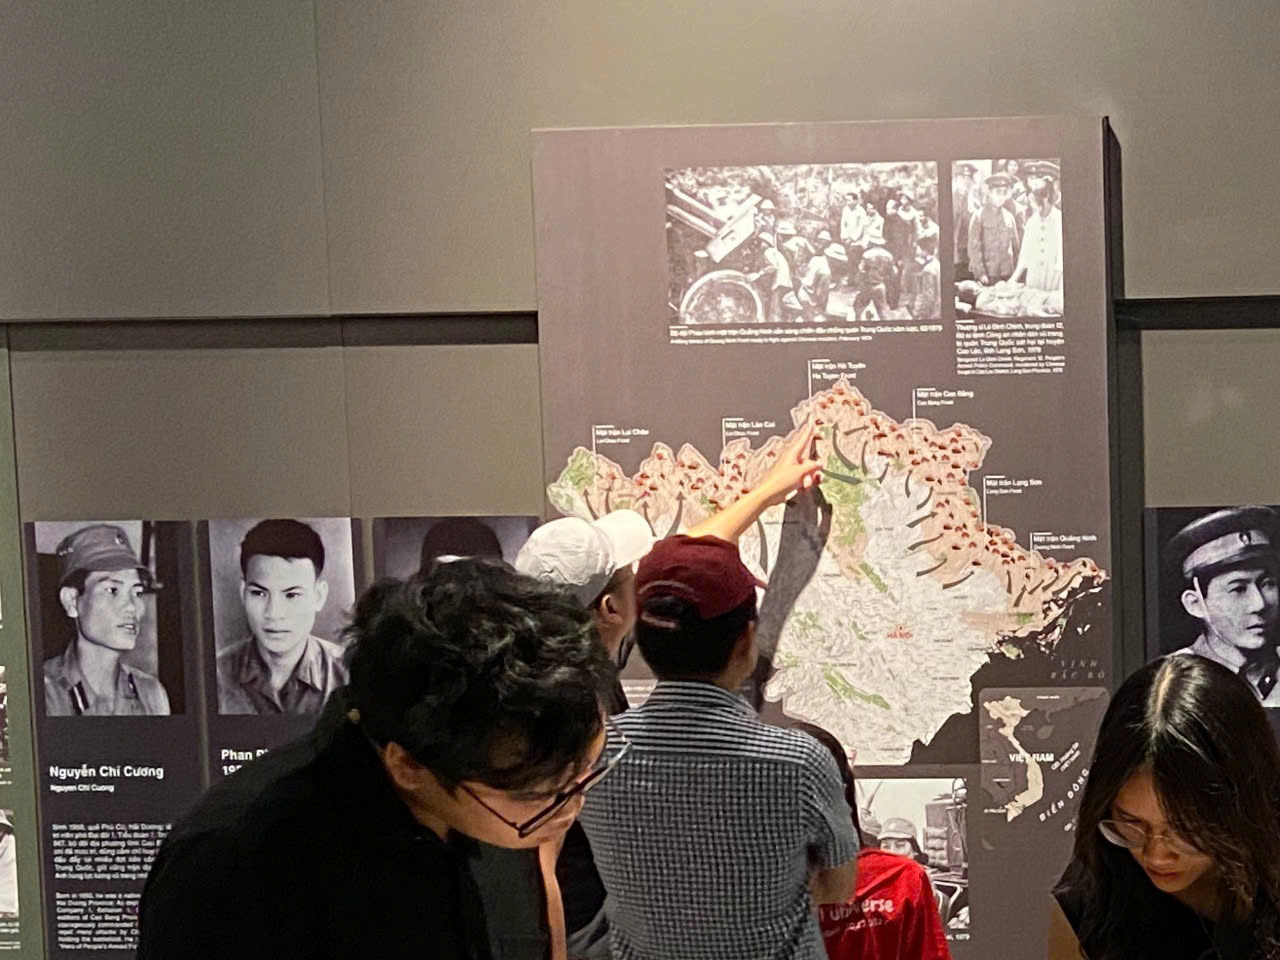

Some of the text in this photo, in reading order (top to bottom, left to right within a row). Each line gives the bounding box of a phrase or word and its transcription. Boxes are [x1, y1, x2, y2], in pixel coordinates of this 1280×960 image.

[221, 748, 253, 760] Phan
[49, 763, 96, 780] Nguyễn
[123, 765, 164, 780] Cương
